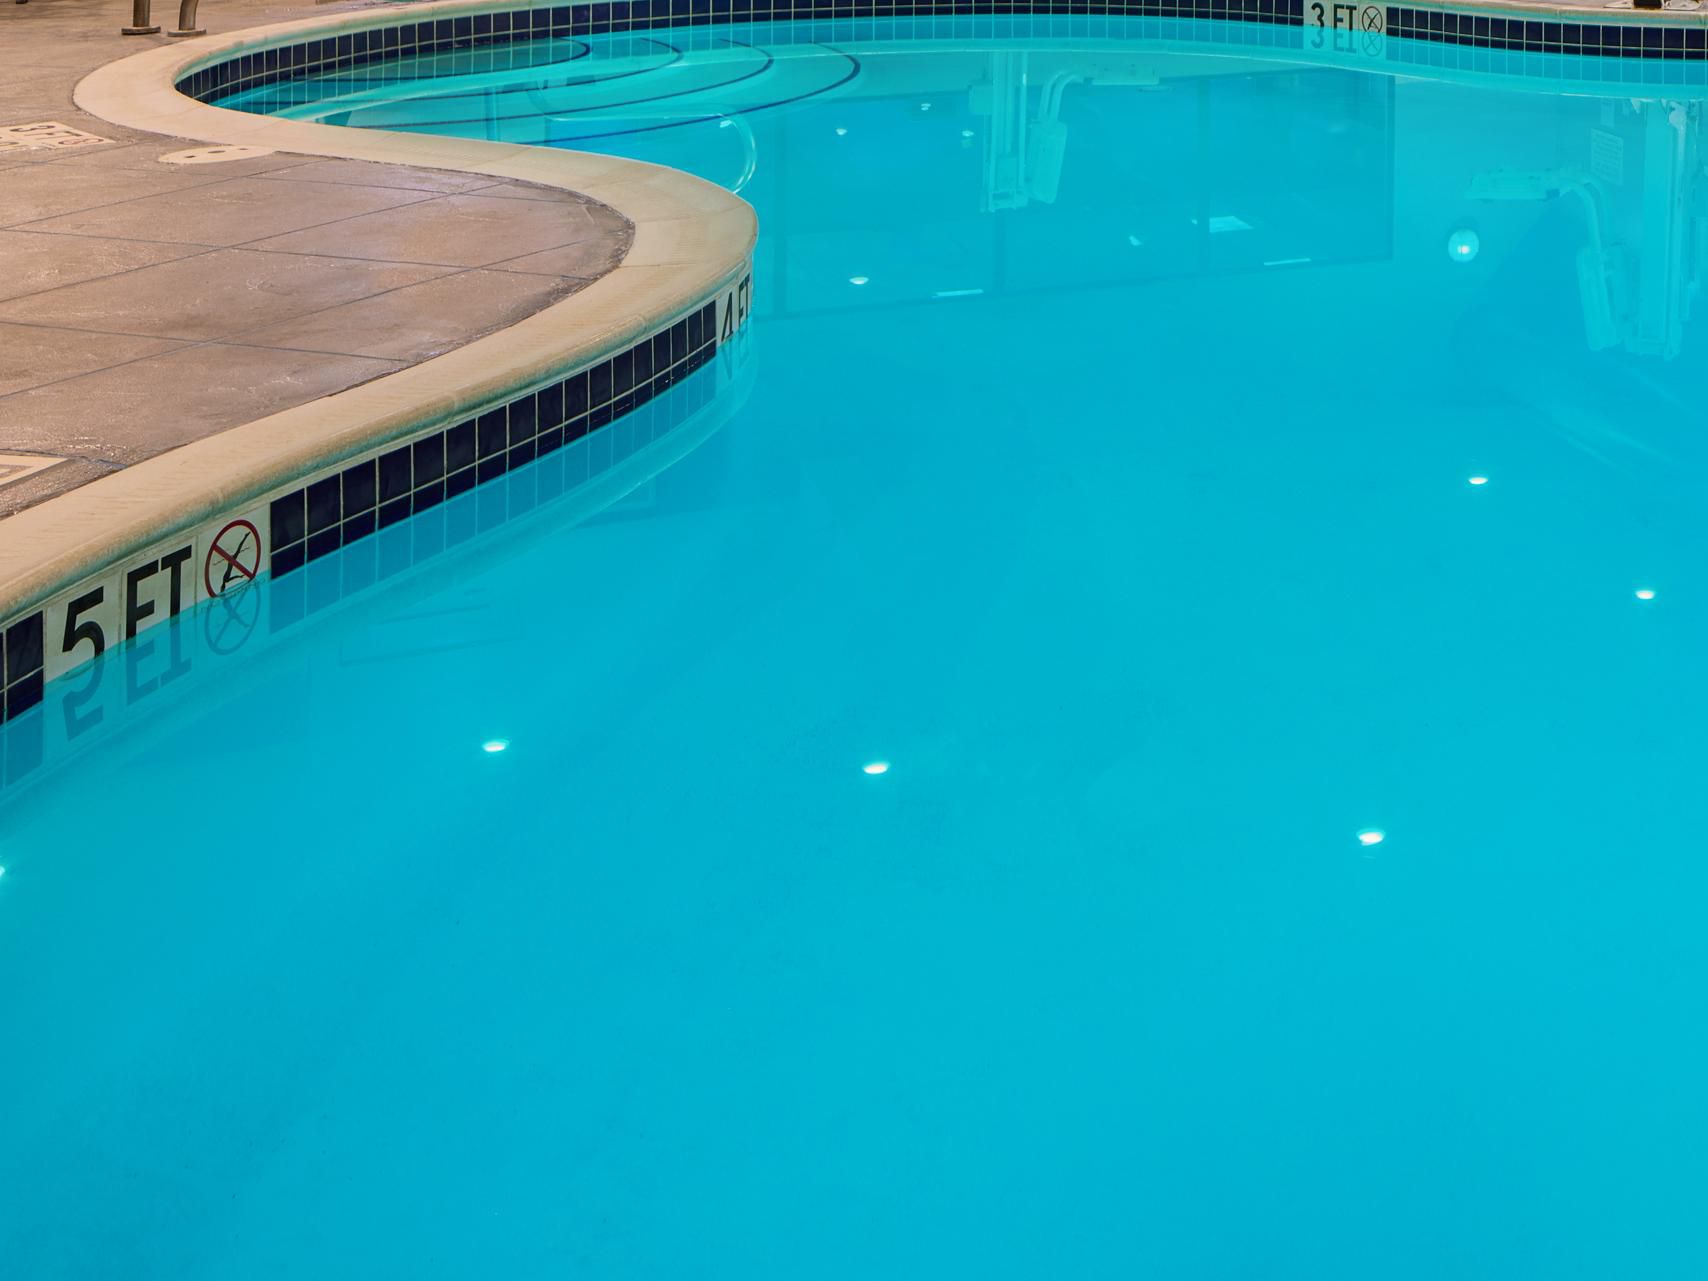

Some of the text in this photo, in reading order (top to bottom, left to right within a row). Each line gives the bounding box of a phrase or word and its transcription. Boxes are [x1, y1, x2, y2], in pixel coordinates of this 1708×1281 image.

[1311, 2, 1357, 31] 3 FT
[62, 544, 192, 680] 5 FT
